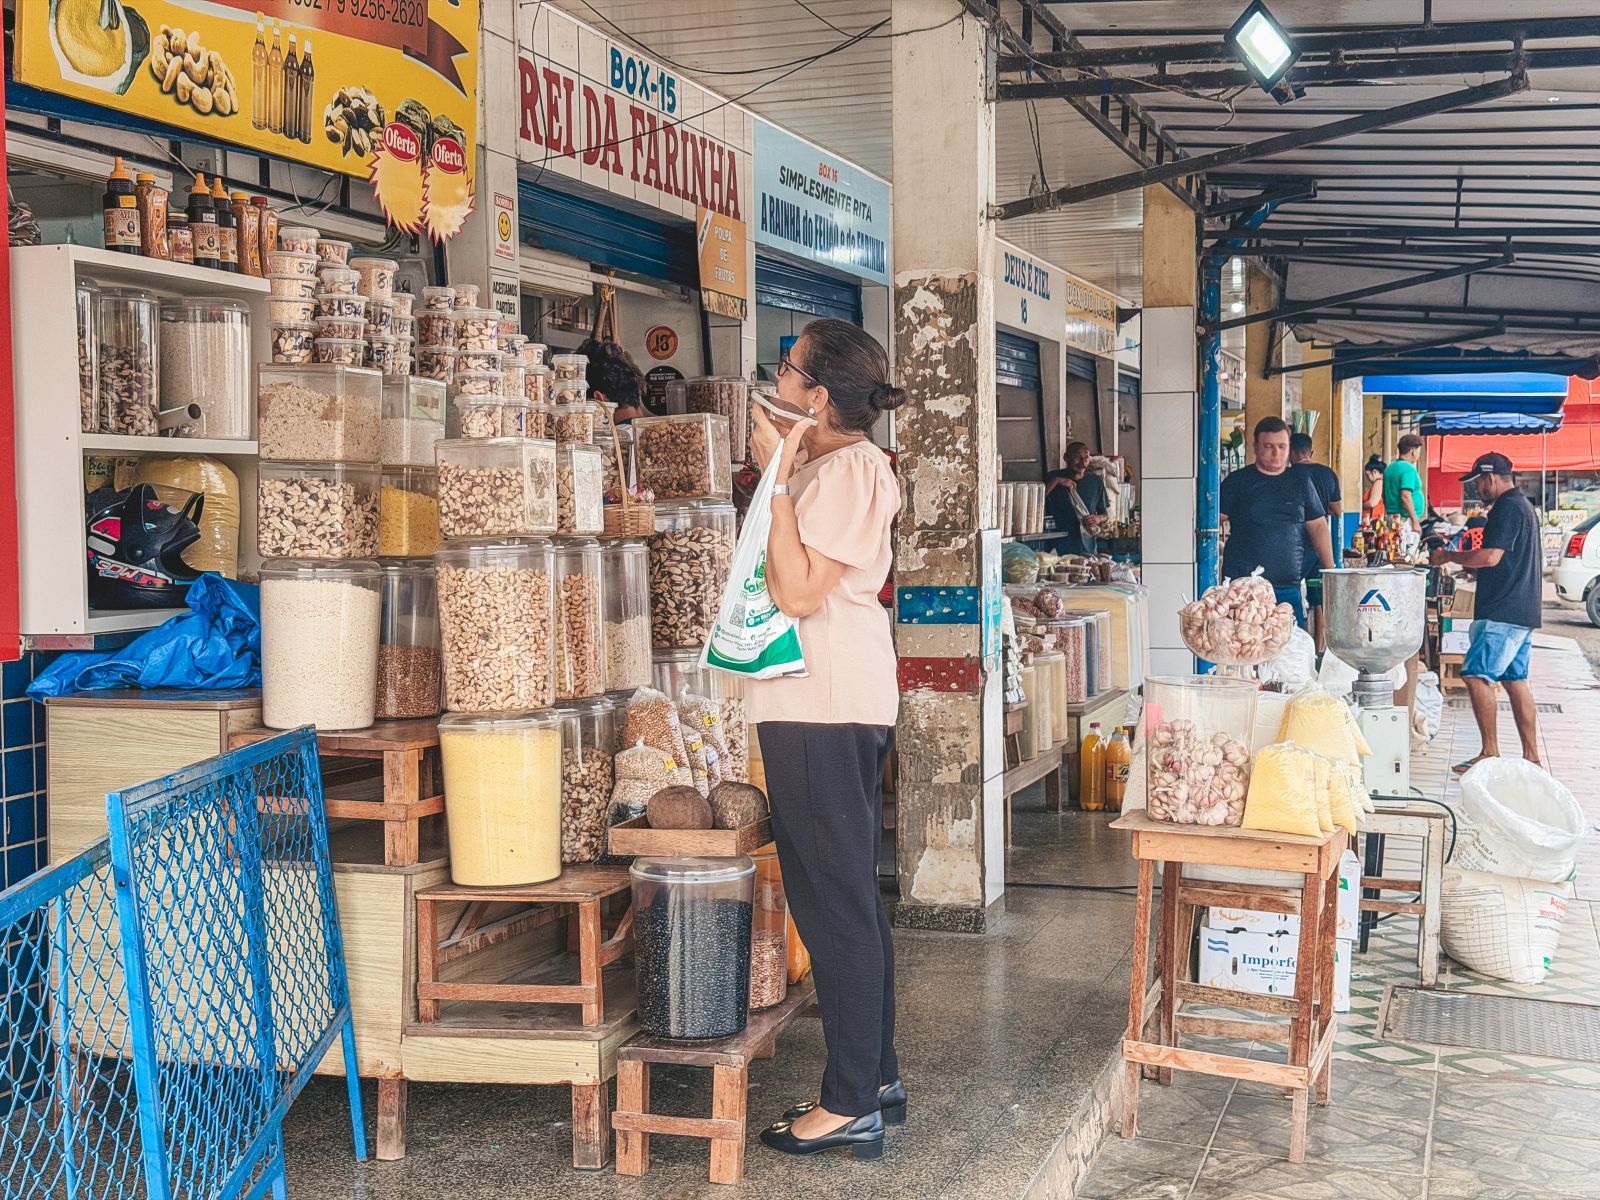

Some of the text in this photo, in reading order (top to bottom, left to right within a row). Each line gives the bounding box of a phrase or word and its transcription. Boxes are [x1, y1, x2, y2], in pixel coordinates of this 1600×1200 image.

[610, 46, 677, 113] BOX-15
[385, 127, 416, 156] Oferta
[518, 55, 741, 221] REI DA FARINHA
[434, 143, 463, 167] Oferta
[818, 161, 832, 180] BOX
[779, 165, 873, 223] SIMPLESMENTE RITA
[761, 191, 768, 232] A
[769, 194, 801, 245] RAINHA
[802, 209, 814, 248] do
[714, 225, 733, 243] POLPA
[719, 246, 729, 262] DE
[715, 266, 736, 285] FRUTAS
[1004, 251, 1051, 300] DEUS É FIEL
[493, 281, 518, 297] ACEITAMOS
[495, 299, 516, 315] CARTÕES
[1020, 297, 1028, 324] 18
[655, 334, 670, 352] 18
